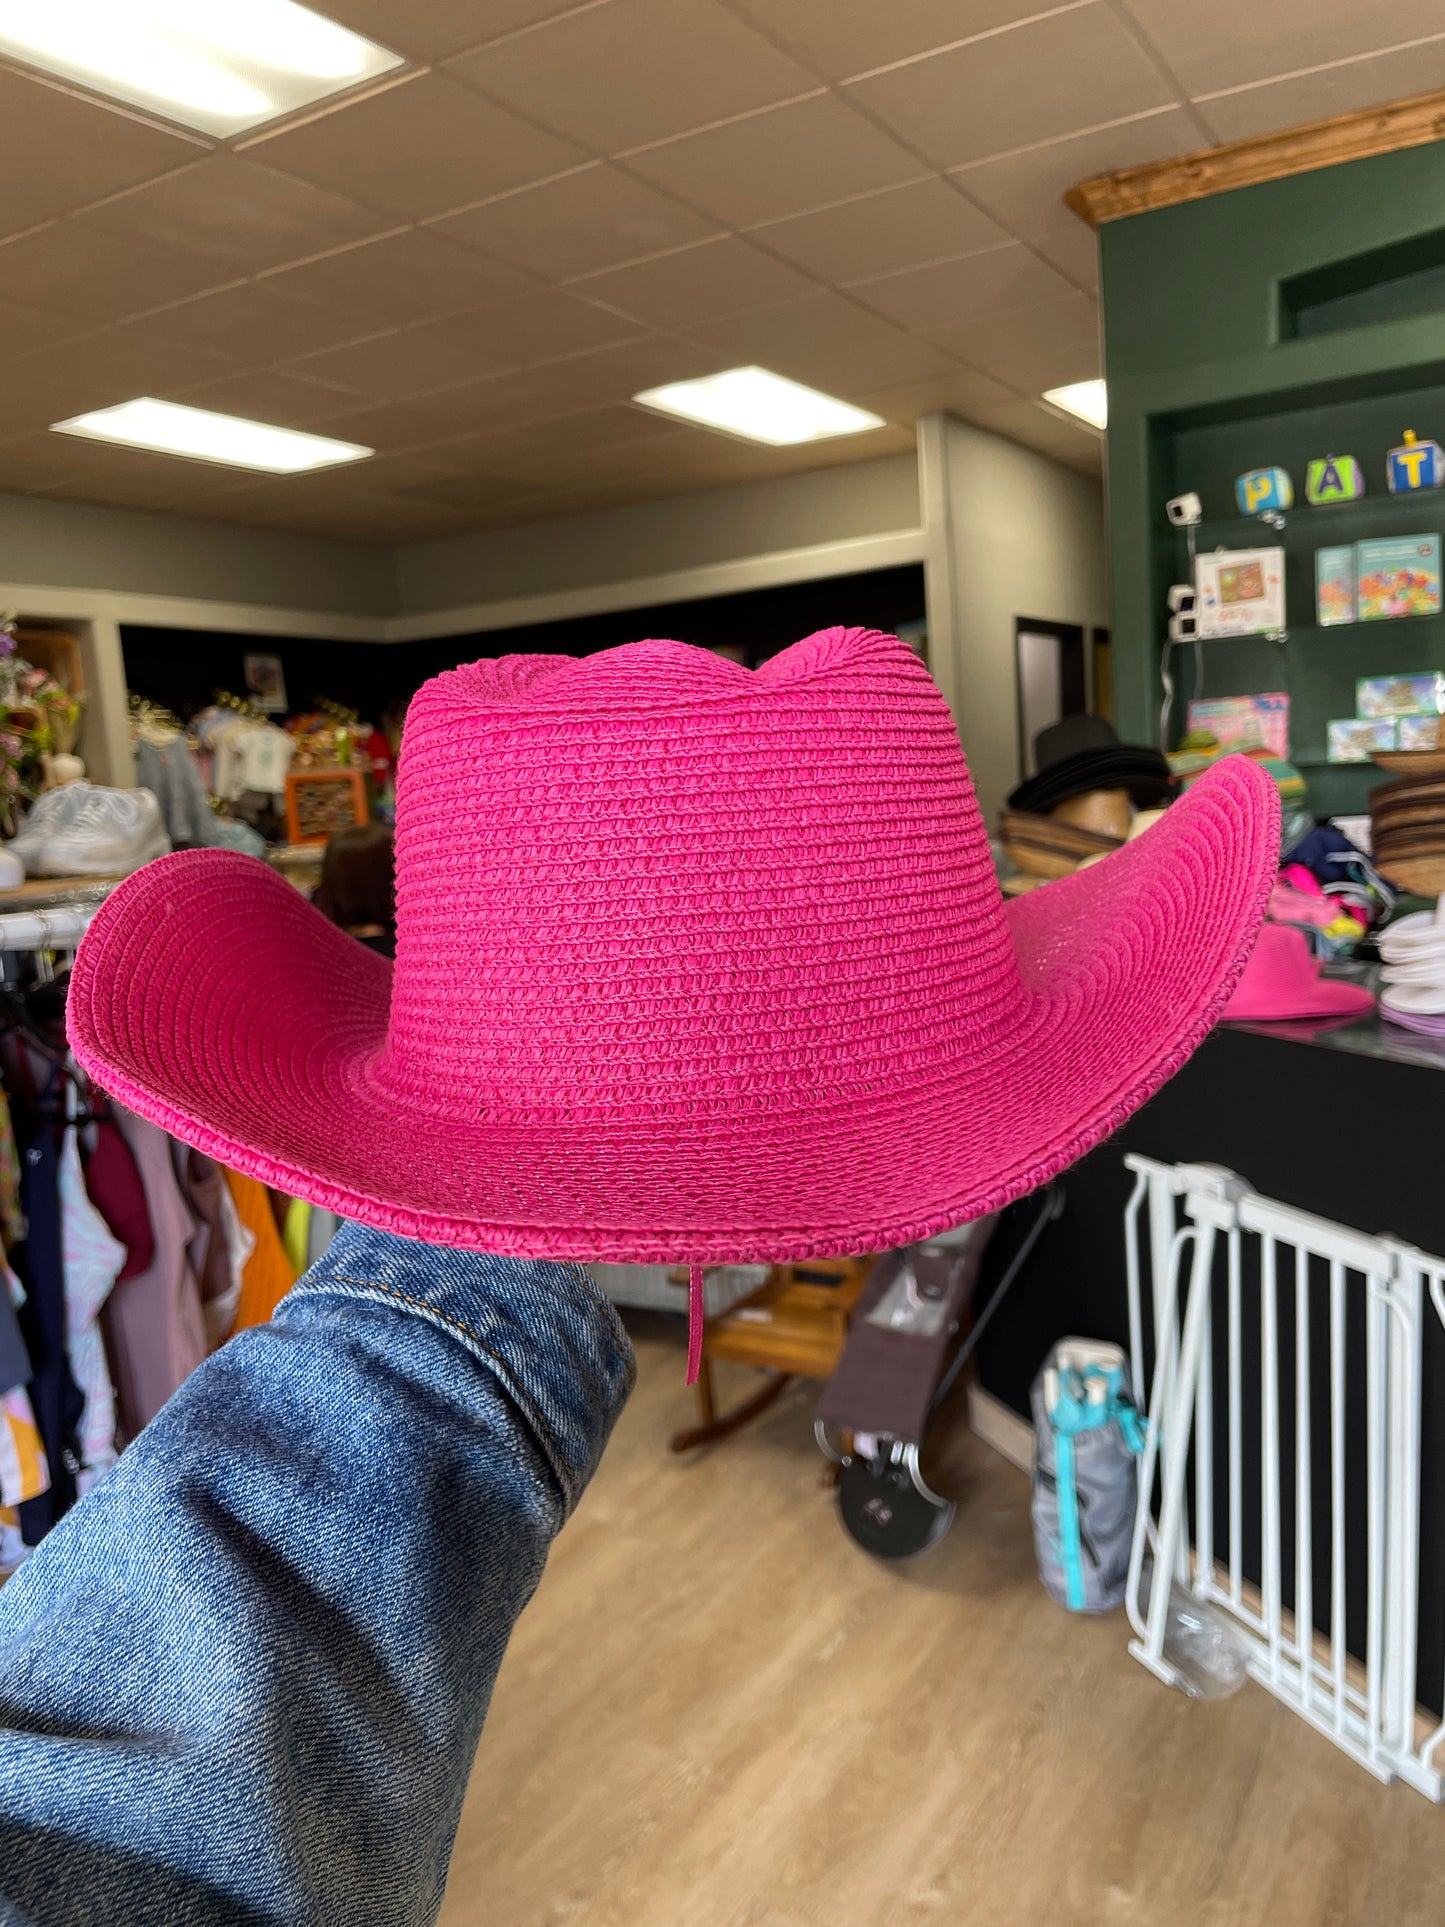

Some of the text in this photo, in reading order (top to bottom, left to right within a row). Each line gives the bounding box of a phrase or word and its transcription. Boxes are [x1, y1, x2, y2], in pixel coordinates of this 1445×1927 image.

[1245, 452, 1427, 512] P A T
